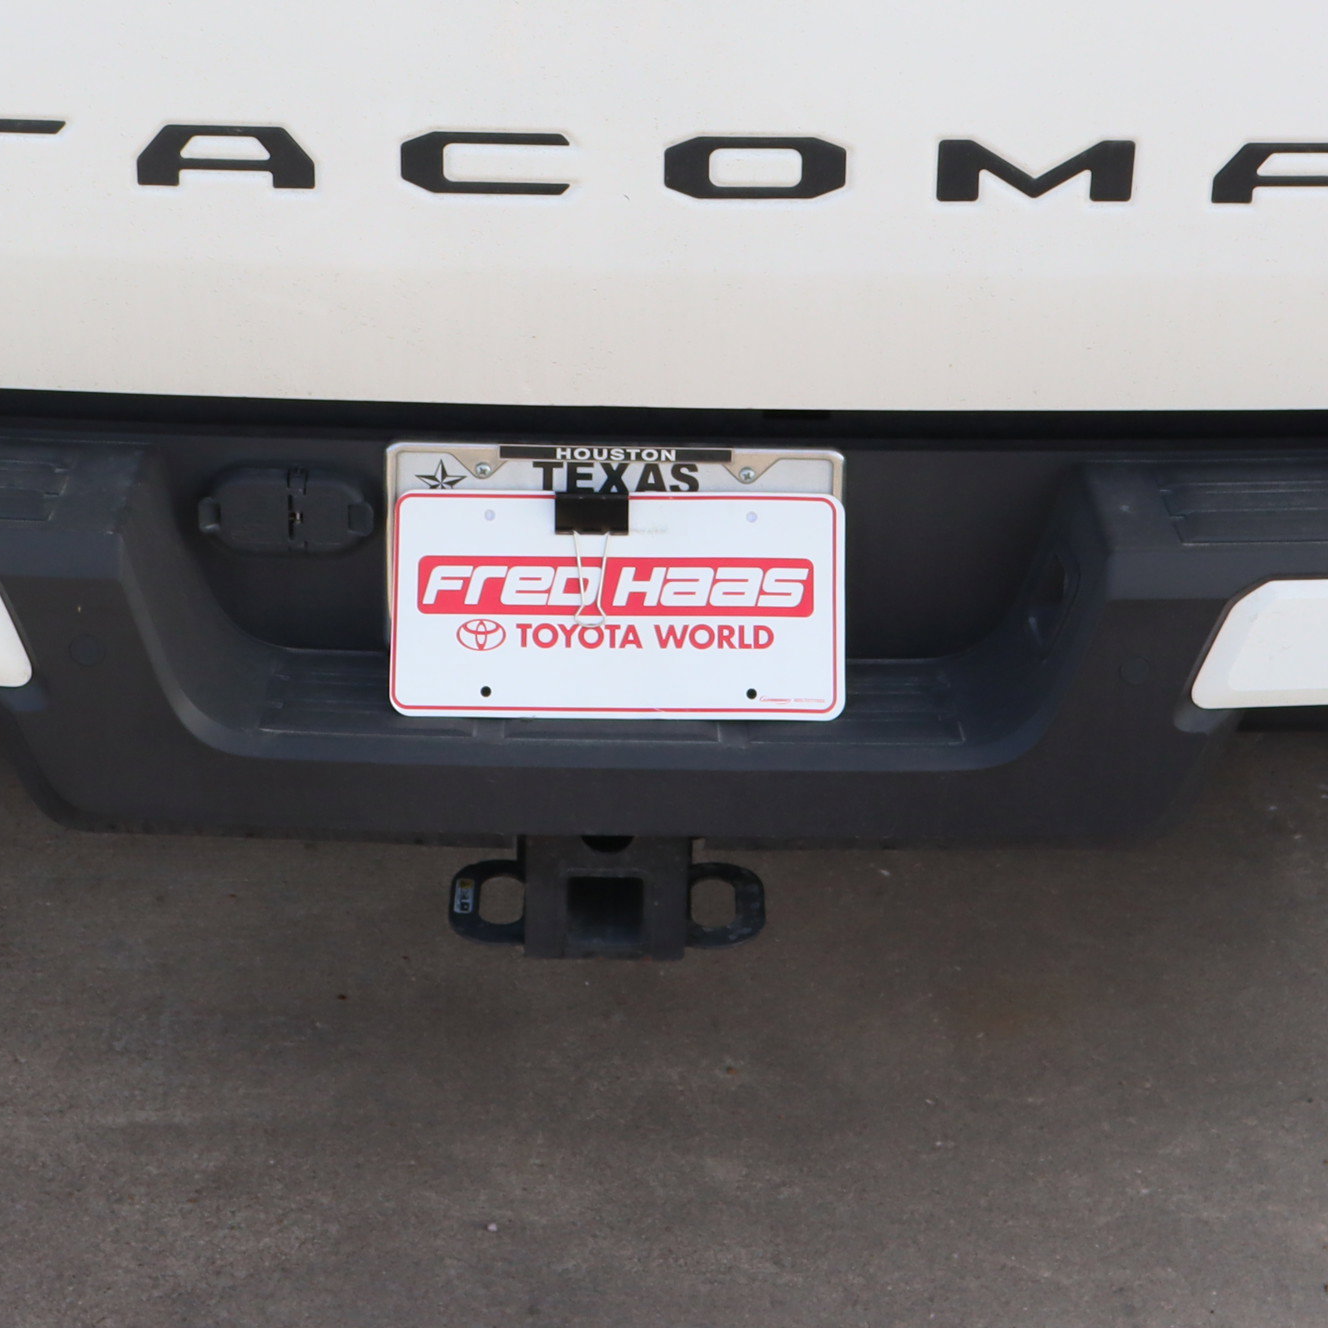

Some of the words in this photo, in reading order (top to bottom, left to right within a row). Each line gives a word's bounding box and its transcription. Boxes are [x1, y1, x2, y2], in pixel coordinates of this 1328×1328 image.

[556, 447, 677, 462] HOUSTON
[532, 460, 700, 494] TEXAS
[516, 623, 643, 649] TOYOTA
[654, 624, 775, 650] WORLD
